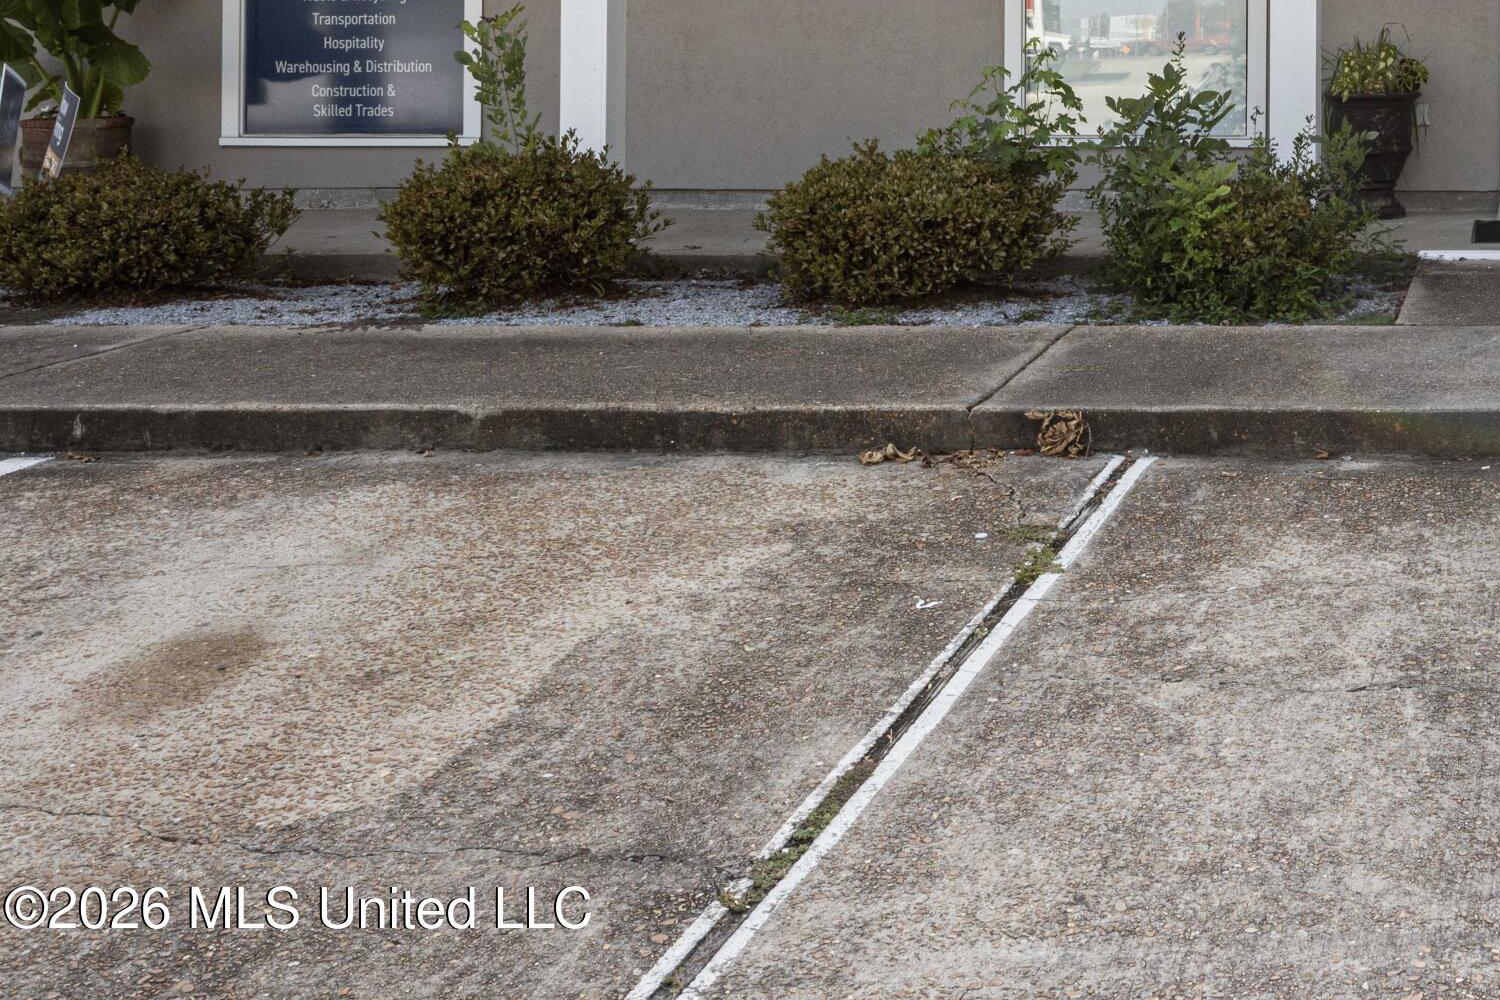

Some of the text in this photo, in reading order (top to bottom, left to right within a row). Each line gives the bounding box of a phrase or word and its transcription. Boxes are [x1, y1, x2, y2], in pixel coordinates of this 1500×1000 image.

[312, 12, 396, 28] Transportation
[323, 36, 385, 53] Hospitality
[275, 60, 432, 77] Warehousing & Distribution
[311, 83, 396, 98] Construction &
[313, 103, 395, 118] Skilled Trades
